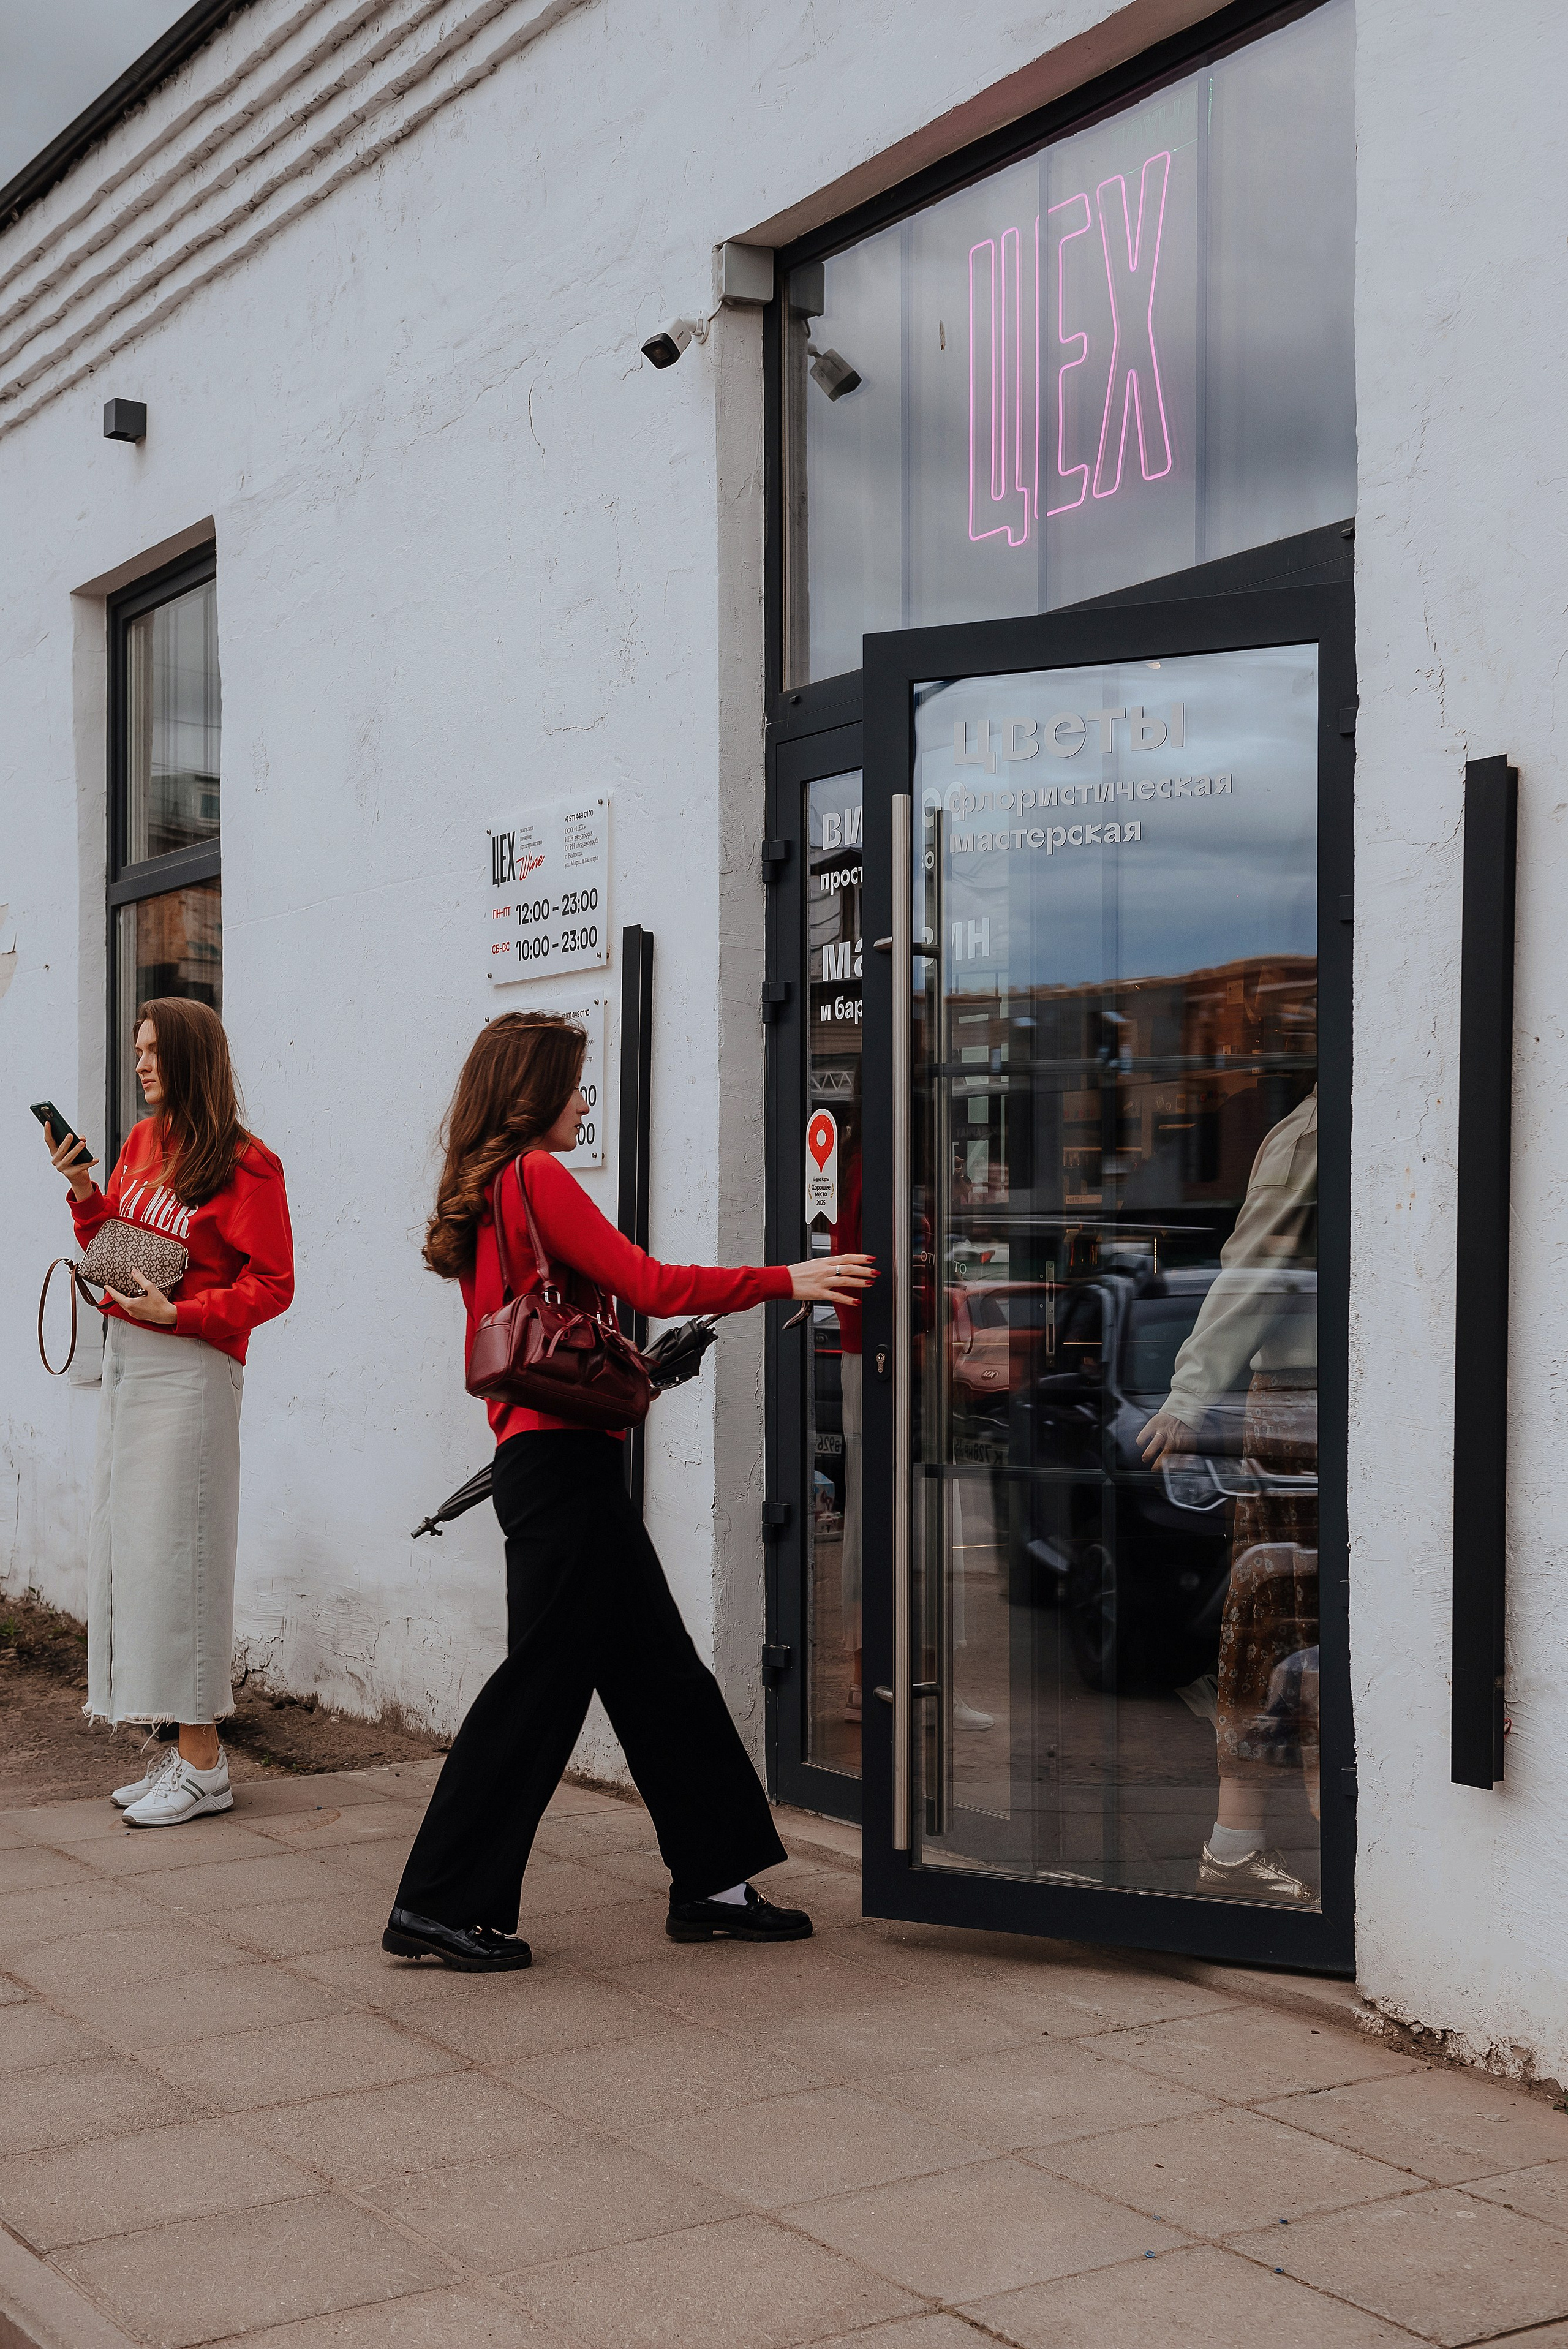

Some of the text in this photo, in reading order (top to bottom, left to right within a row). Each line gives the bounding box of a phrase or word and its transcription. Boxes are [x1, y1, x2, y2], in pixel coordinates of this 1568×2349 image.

[969, 151, 1172, 547] ЦЕХ
[953, 703, 1185, 774] цветы
[949, 773, 1233, 821] флористическая
[520, 840, 543, 851] пространство
[950, 821, 1142, 856] мастерская
[492, 831, 516, 888] ЦЕХ
[516, 851, 545, 881] Wine
[492, 906, 511, 919] ПН-ПТ
[516, 899, 550, 926] 12:00
[562, 888, 598, 916] 23:00
[491, 941, 510, 954] СБ-ВС
[516, 935, 550, 962] 10:00
[562, 925, 598, 953] 23:00
[821, 1005, 831, 1022] и
[140, 1185, 199, 1239] MER
